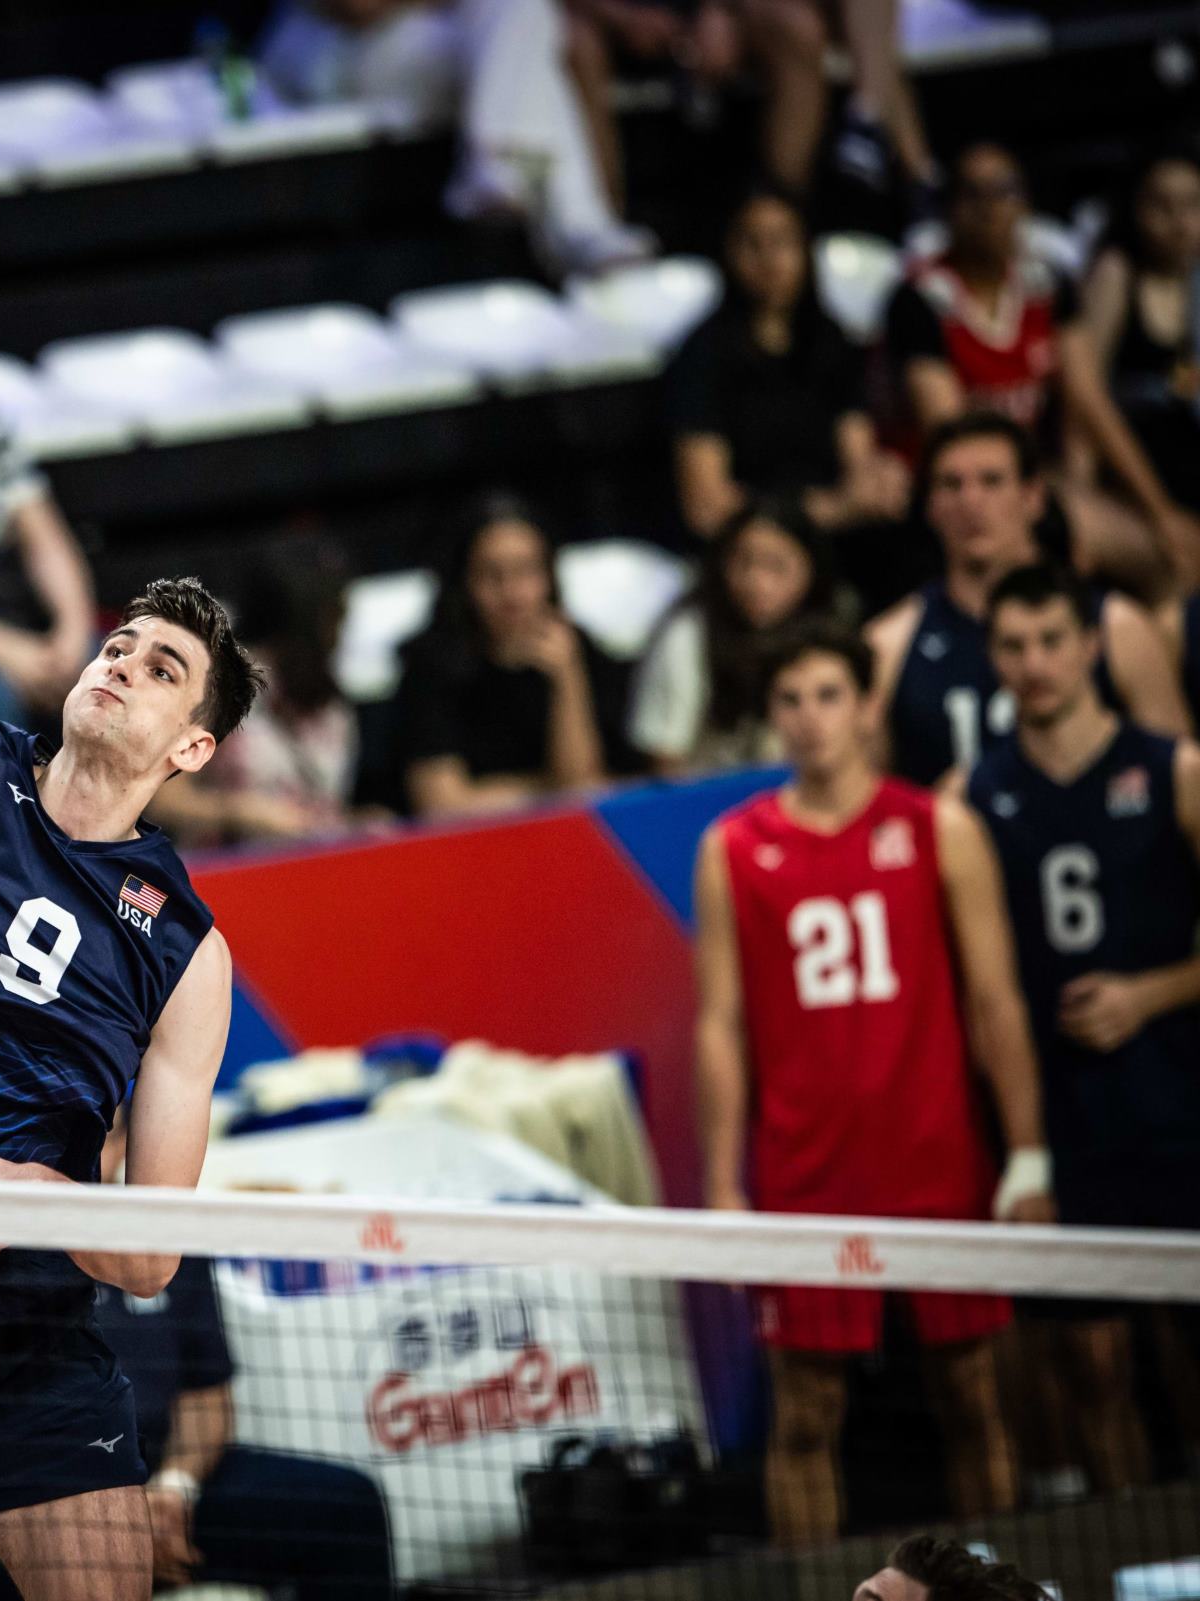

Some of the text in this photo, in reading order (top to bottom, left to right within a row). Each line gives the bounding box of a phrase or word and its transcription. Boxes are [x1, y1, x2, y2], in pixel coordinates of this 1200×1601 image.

[117, 898, 152, 938] USA
[787, 889, 900, 1009] 21
[1040, 843, 1104, 953] 6
